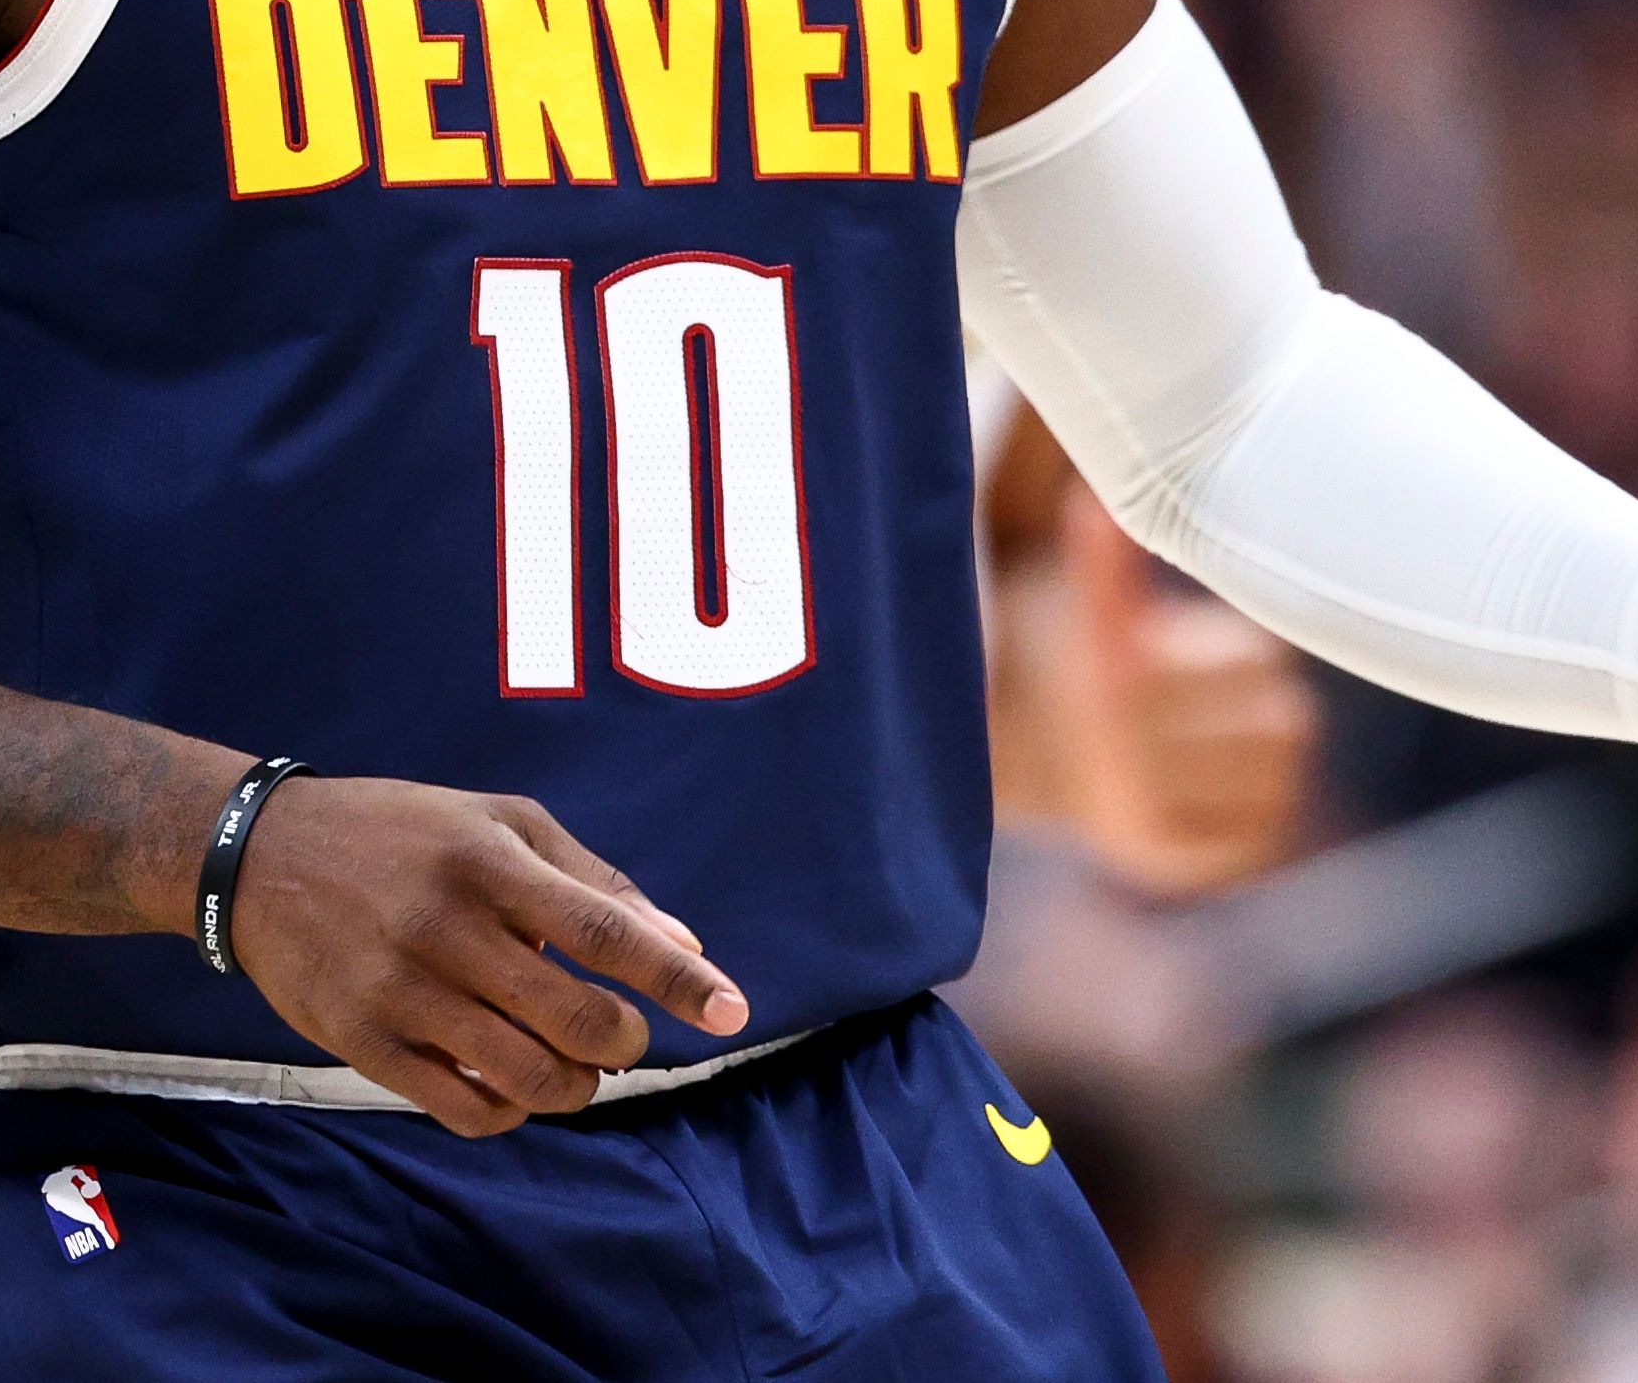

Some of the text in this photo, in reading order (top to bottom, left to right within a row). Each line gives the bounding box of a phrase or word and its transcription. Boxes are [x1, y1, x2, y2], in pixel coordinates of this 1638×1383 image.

[470, 250, 818, 700] 10
[217, 809, 243, 847] TIM
[64, 1227, 100, 1260] NBA
